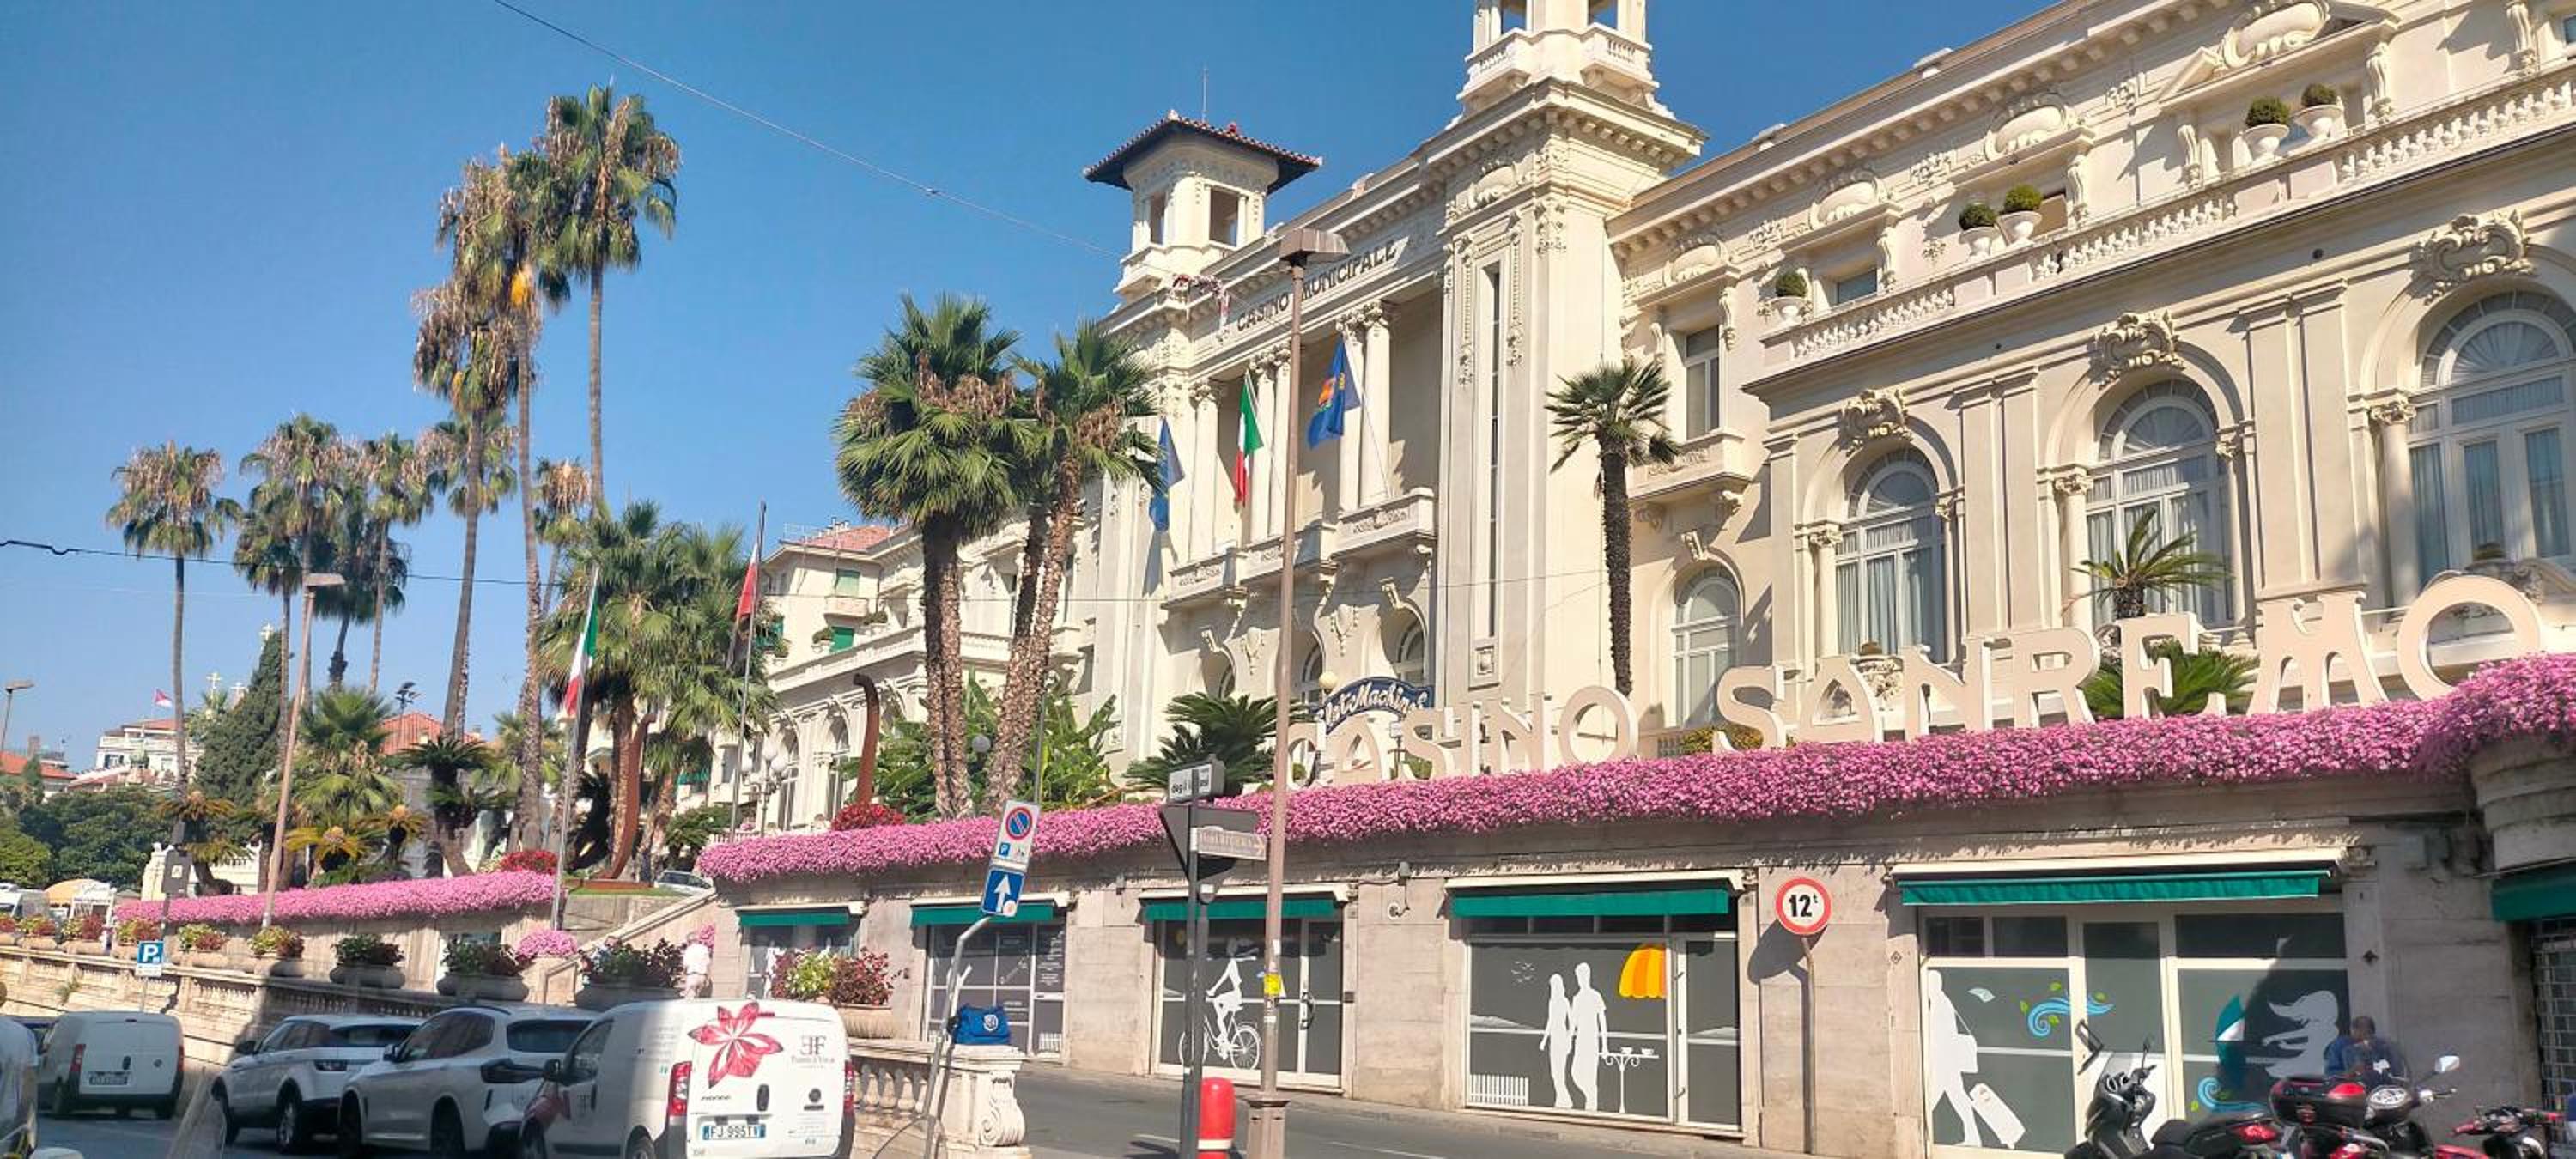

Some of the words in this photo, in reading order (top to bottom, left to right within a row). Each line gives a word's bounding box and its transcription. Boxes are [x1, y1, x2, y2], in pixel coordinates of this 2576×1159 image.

[1236, 292, 1290, 331] CASINO
[1301, 240, 1397, 301] MUNICIPALE
[1285, 686, 1637, 790] CASINO
[1713, 575, 2545, 752] SANREMO
